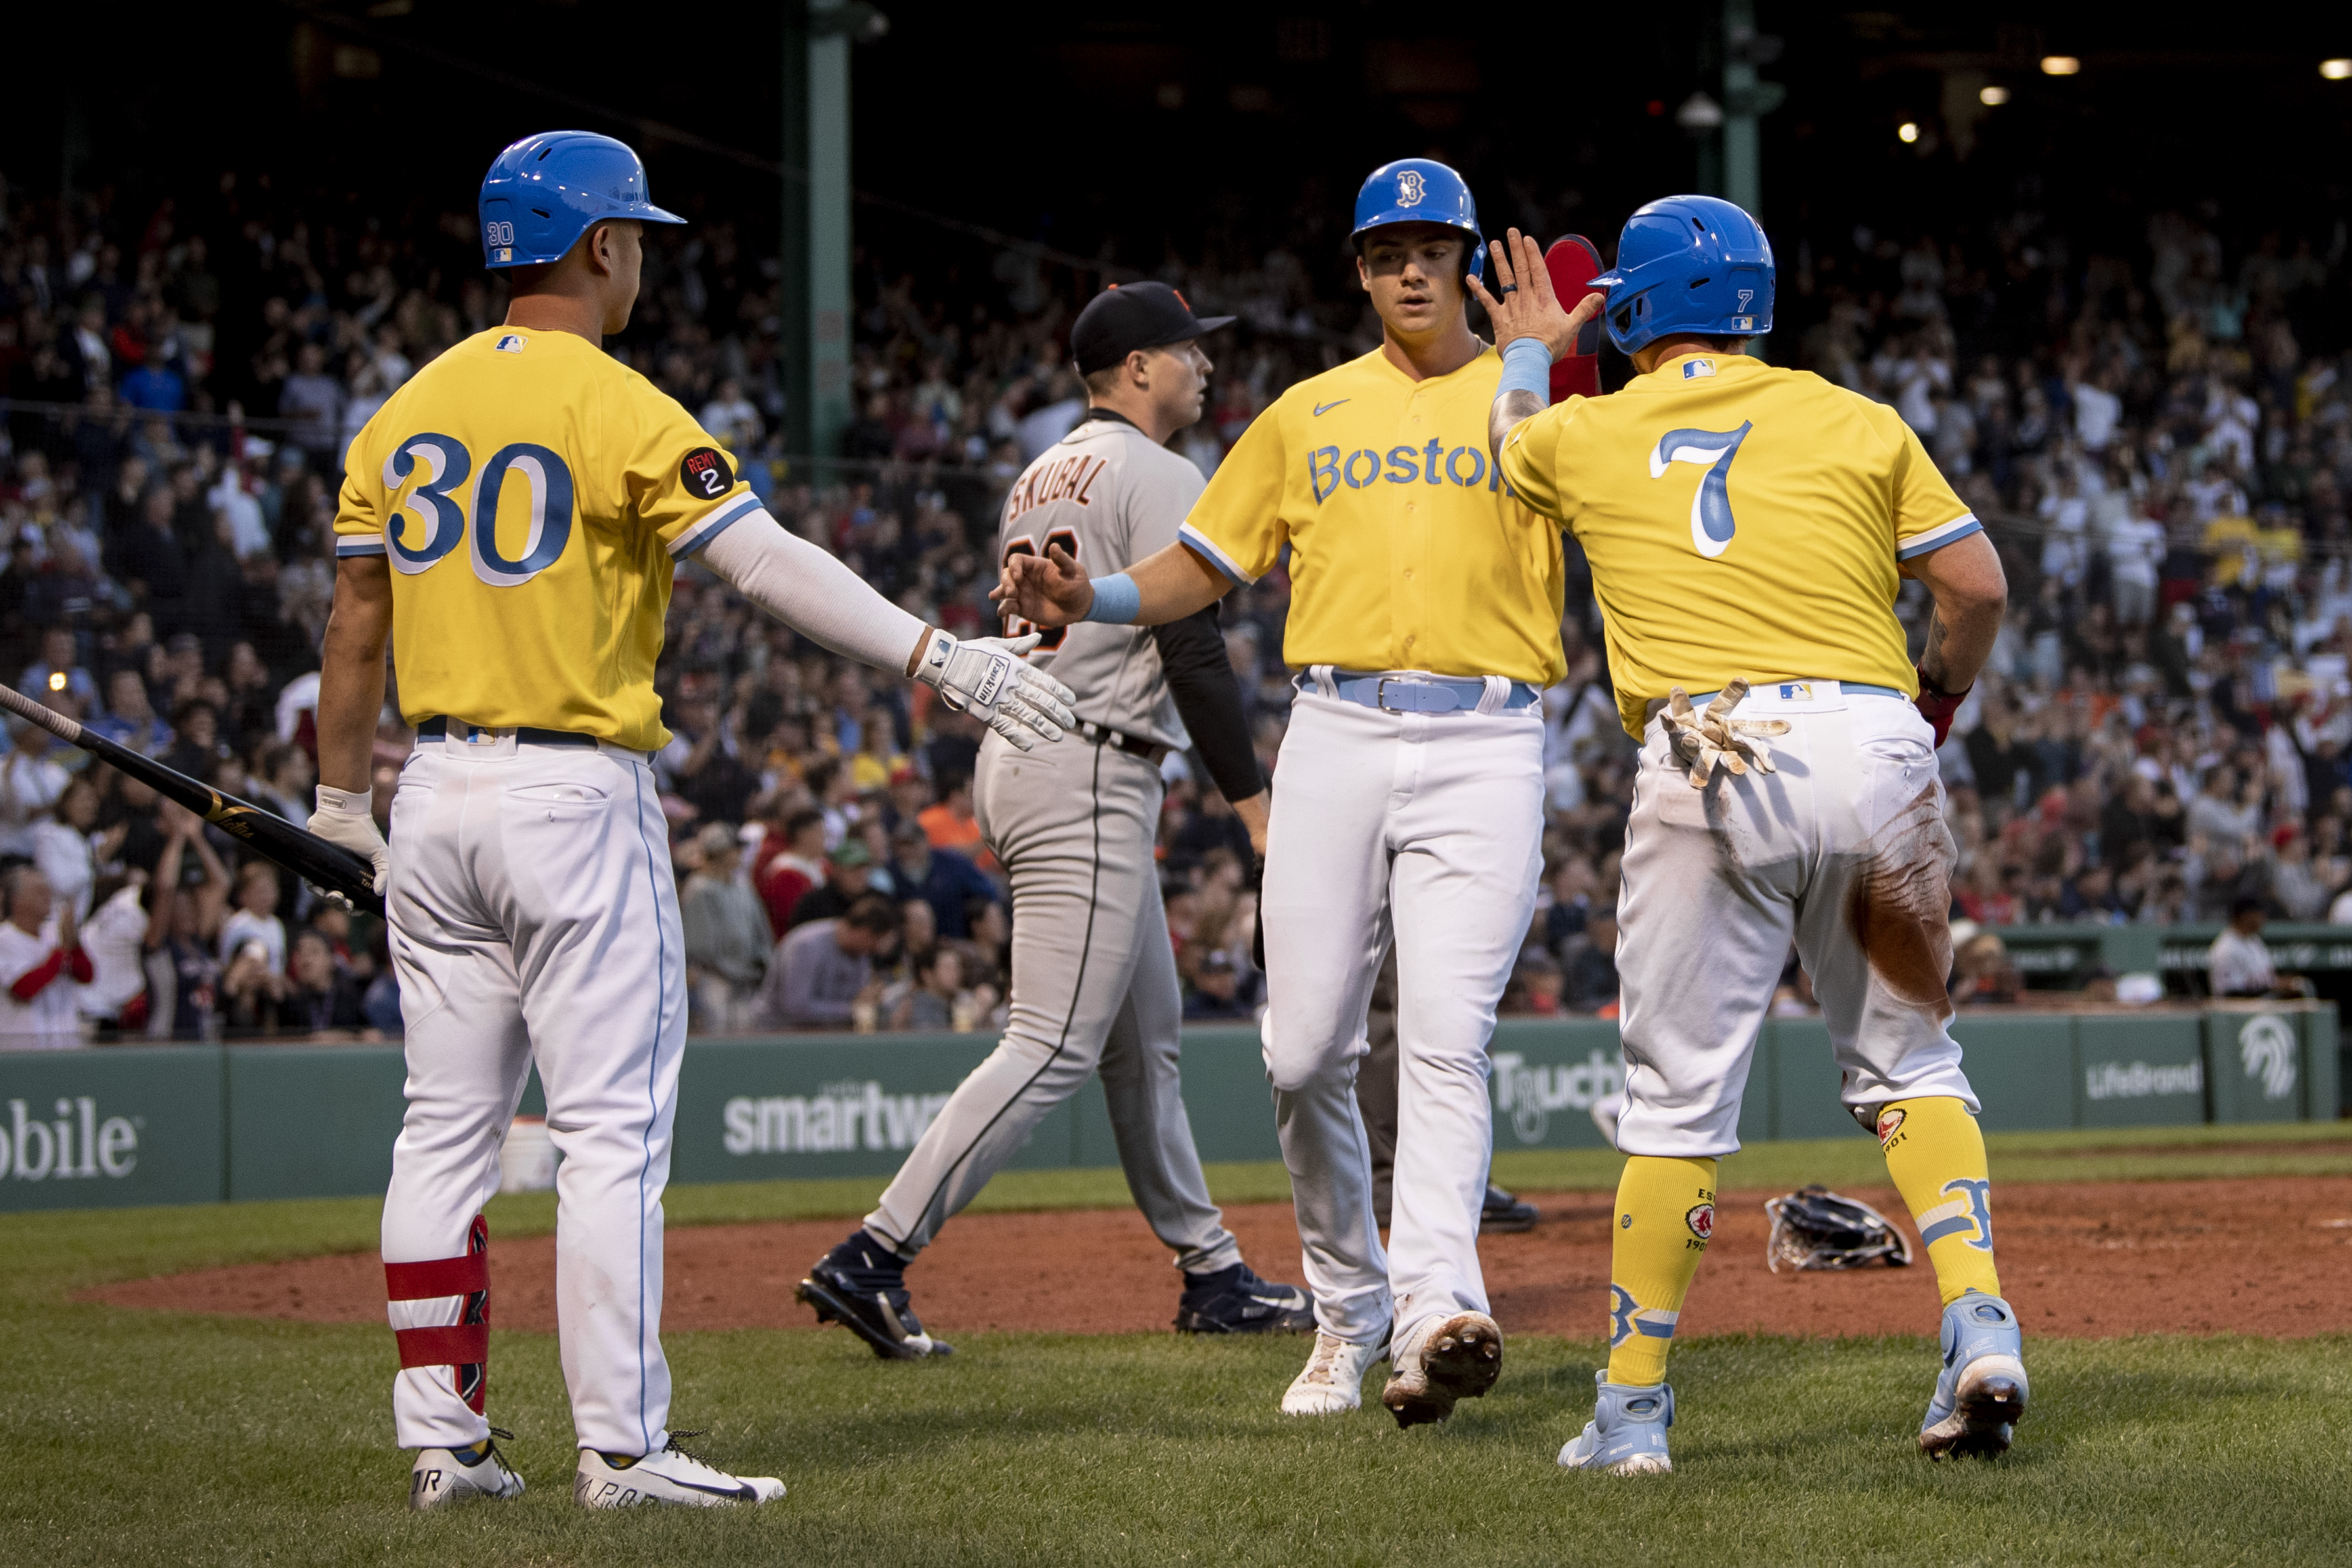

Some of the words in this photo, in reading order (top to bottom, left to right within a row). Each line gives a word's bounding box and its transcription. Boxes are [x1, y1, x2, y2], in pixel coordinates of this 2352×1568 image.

[1397, 171, 1426, 207] B
[487, 222, 514, 245] 30
[1738, 289, 1753, 312] 7
[687, 451, 717, 475] REMY
[700, 468, 725, 495] 2
[1009, 454, 1107, 522] SKUBAL
[1649, 419, 1753, 558] 7
[383, 432, 574, 587] 30
